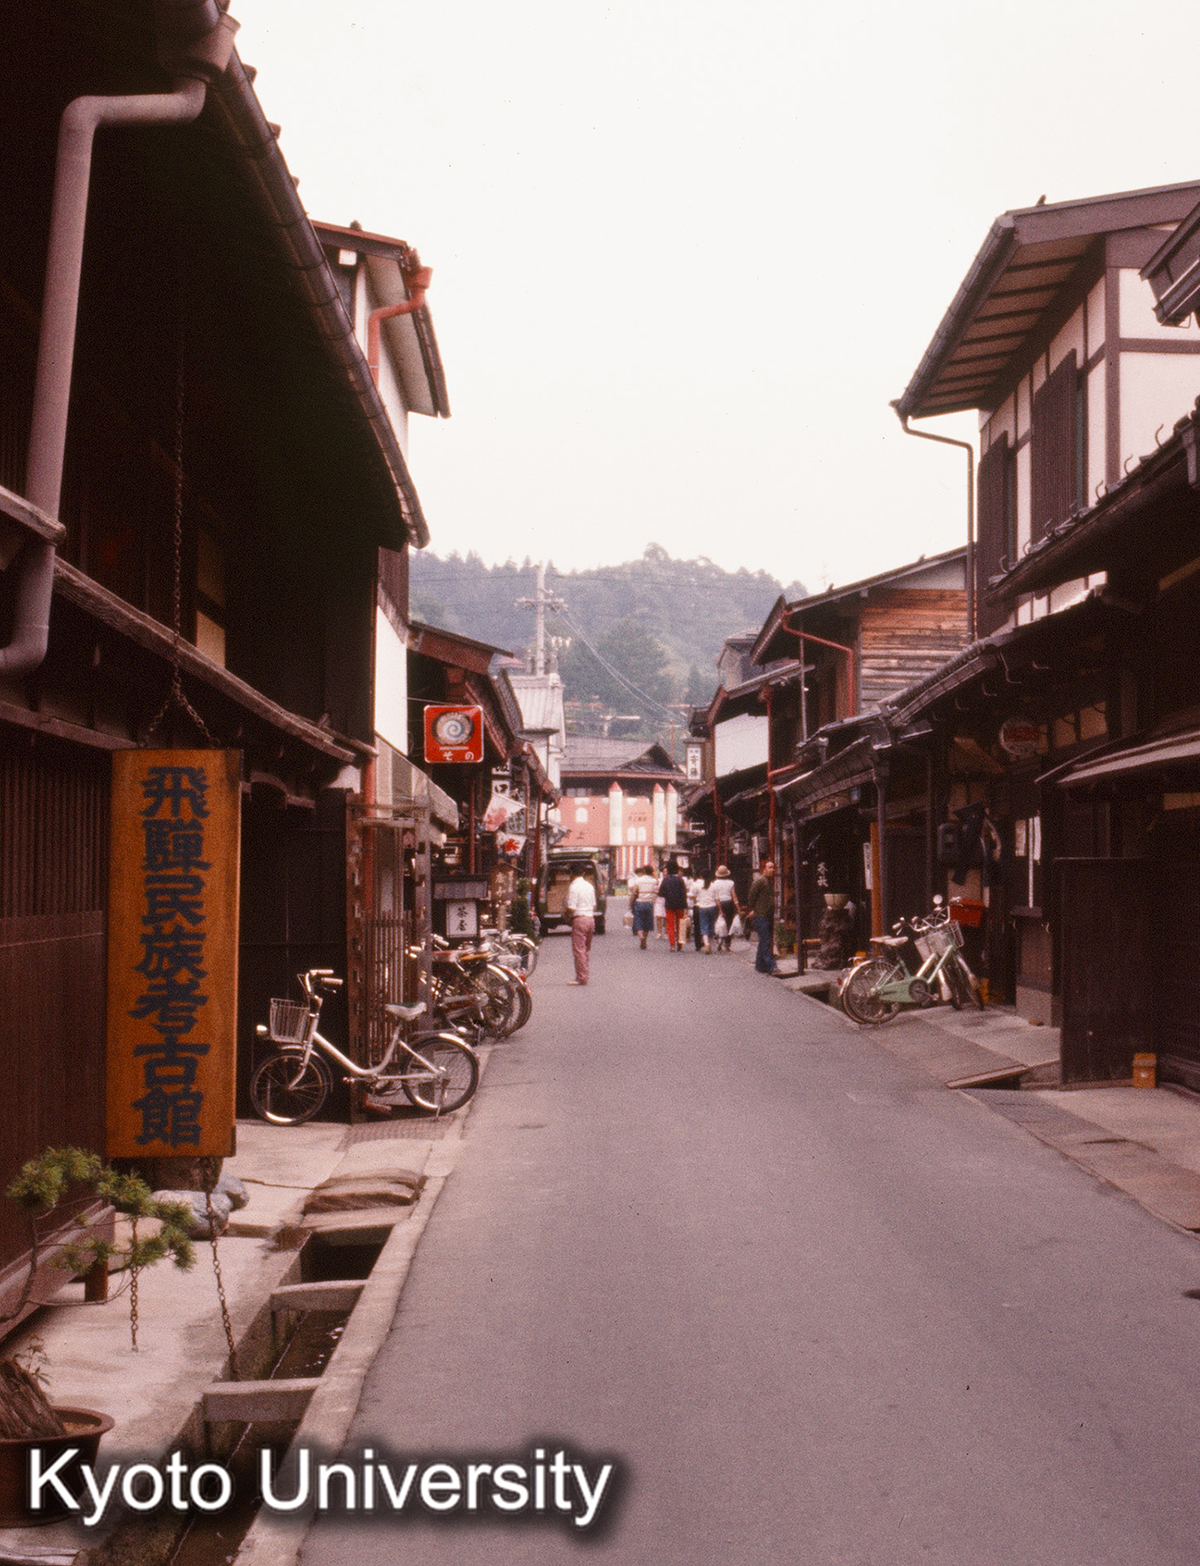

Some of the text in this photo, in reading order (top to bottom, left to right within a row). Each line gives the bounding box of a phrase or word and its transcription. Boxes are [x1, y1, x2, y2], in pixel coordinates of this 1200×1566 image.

[129, 765, 211, 1148] 飛騨民族考古館
